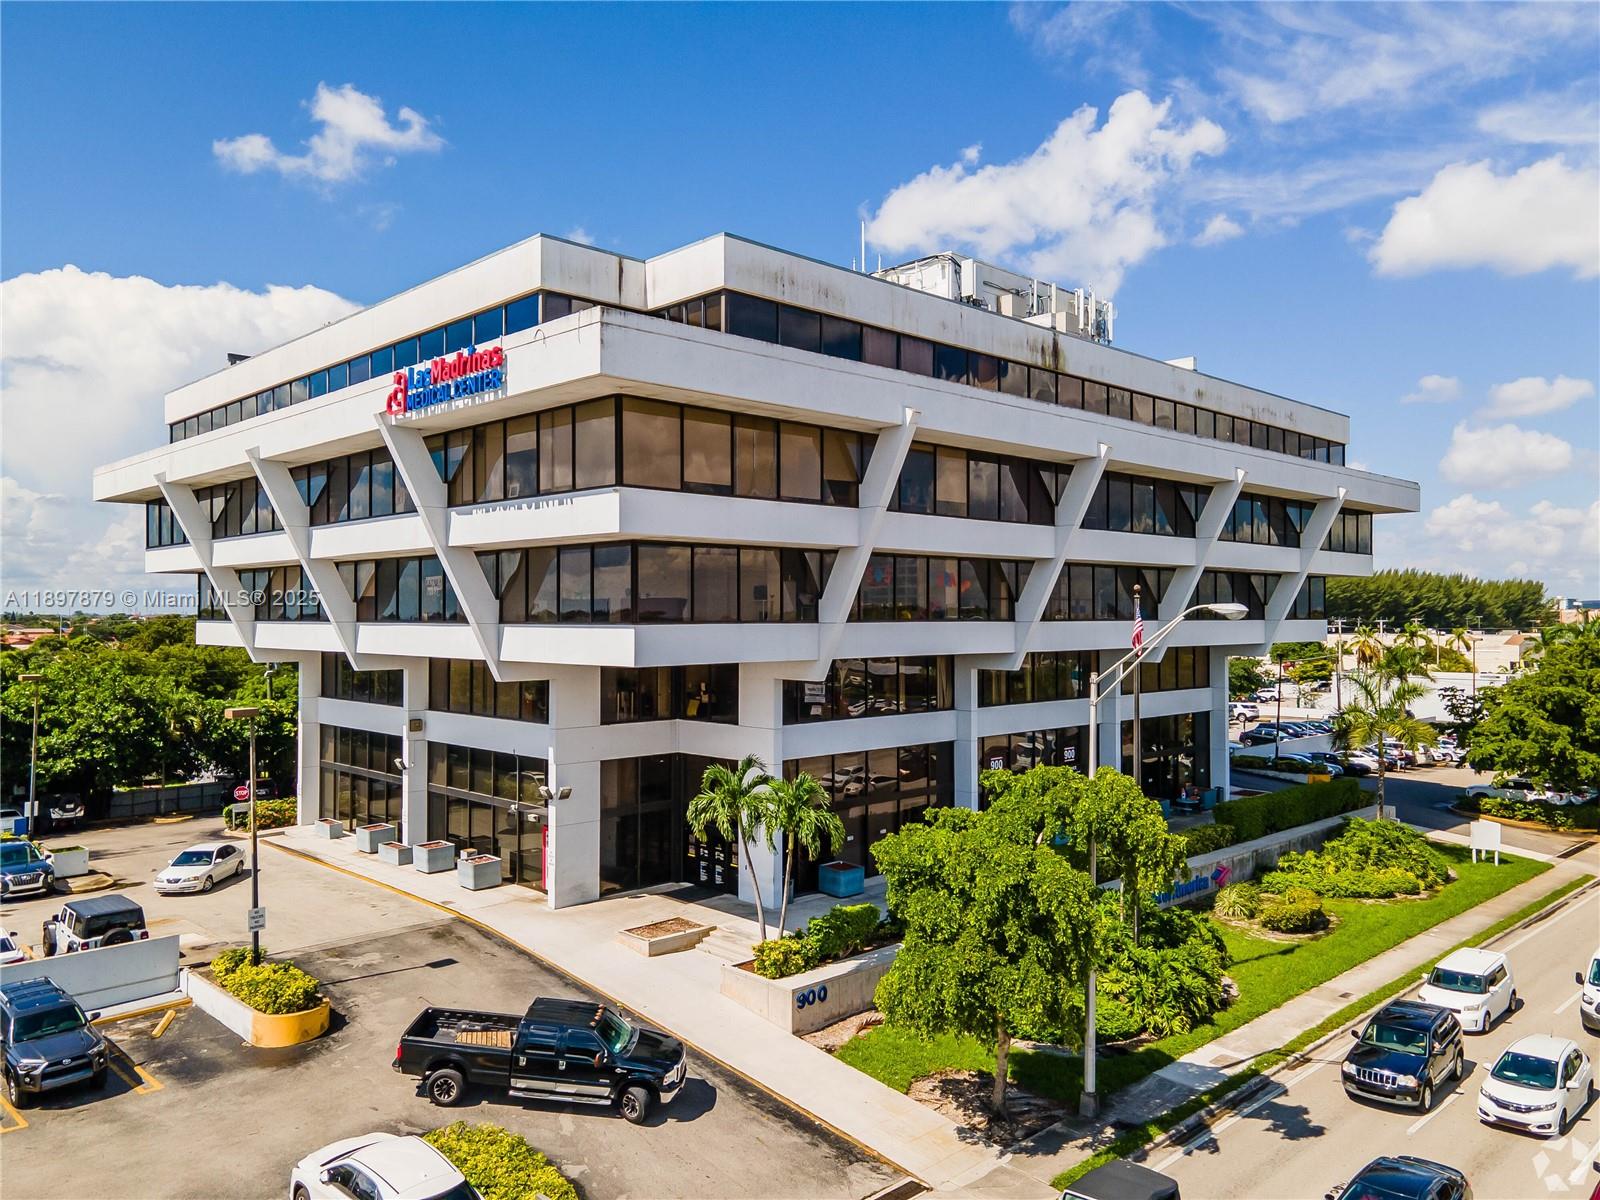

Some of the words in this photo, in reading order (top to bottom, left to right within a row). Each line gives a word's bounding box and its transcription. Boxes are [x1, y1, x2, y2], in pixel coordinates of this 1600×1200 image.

[406, 383, 453, 411] MEDICAL
[454, 367, 504, 398] CENTER
[1063, 749, 1076, 759] 900
[990, 759, 1004, 770] 900
[796, 984, 828, 1009] 900
